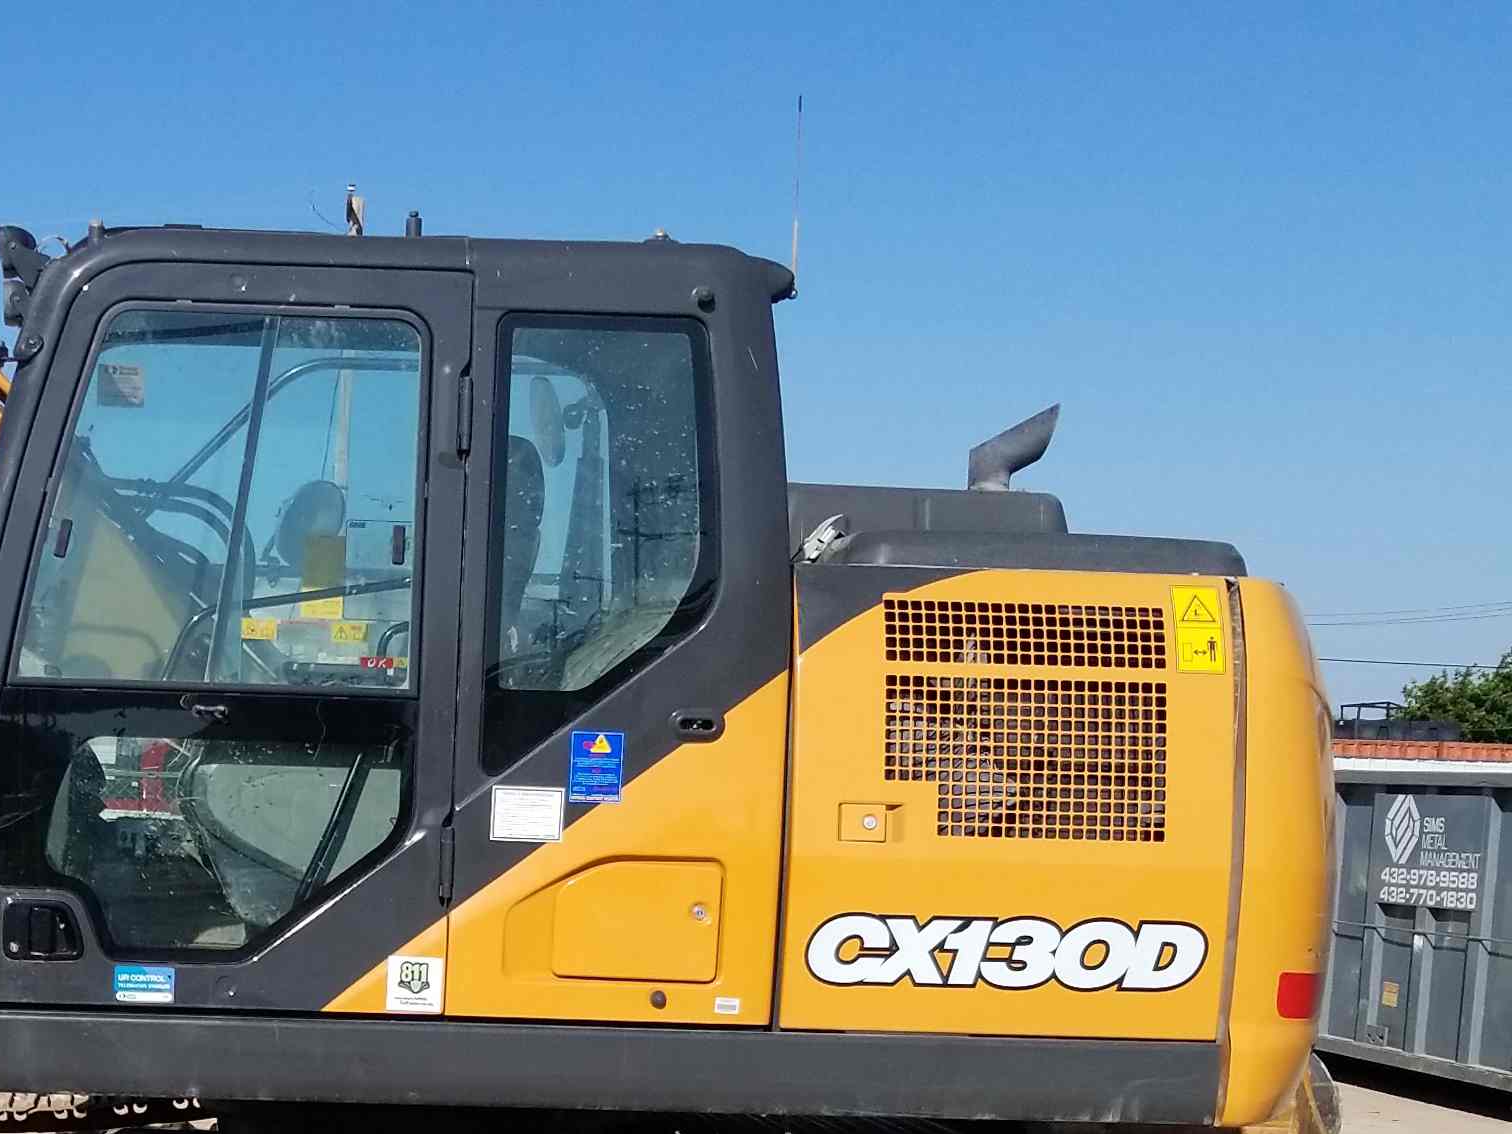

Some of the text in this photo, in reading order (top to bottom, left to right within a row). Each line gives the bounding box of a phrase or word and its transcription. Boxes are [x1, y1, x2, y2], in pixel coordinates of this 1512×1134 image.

[1423, 816, 1445, 833] SIMS
[1422, 833, 1447, 850] METAL
[1420, 851, 1480, 869] MANAGEMENT
[805, 912, 1209, 993] CX130D
[400, 960, 429, 982] 811
